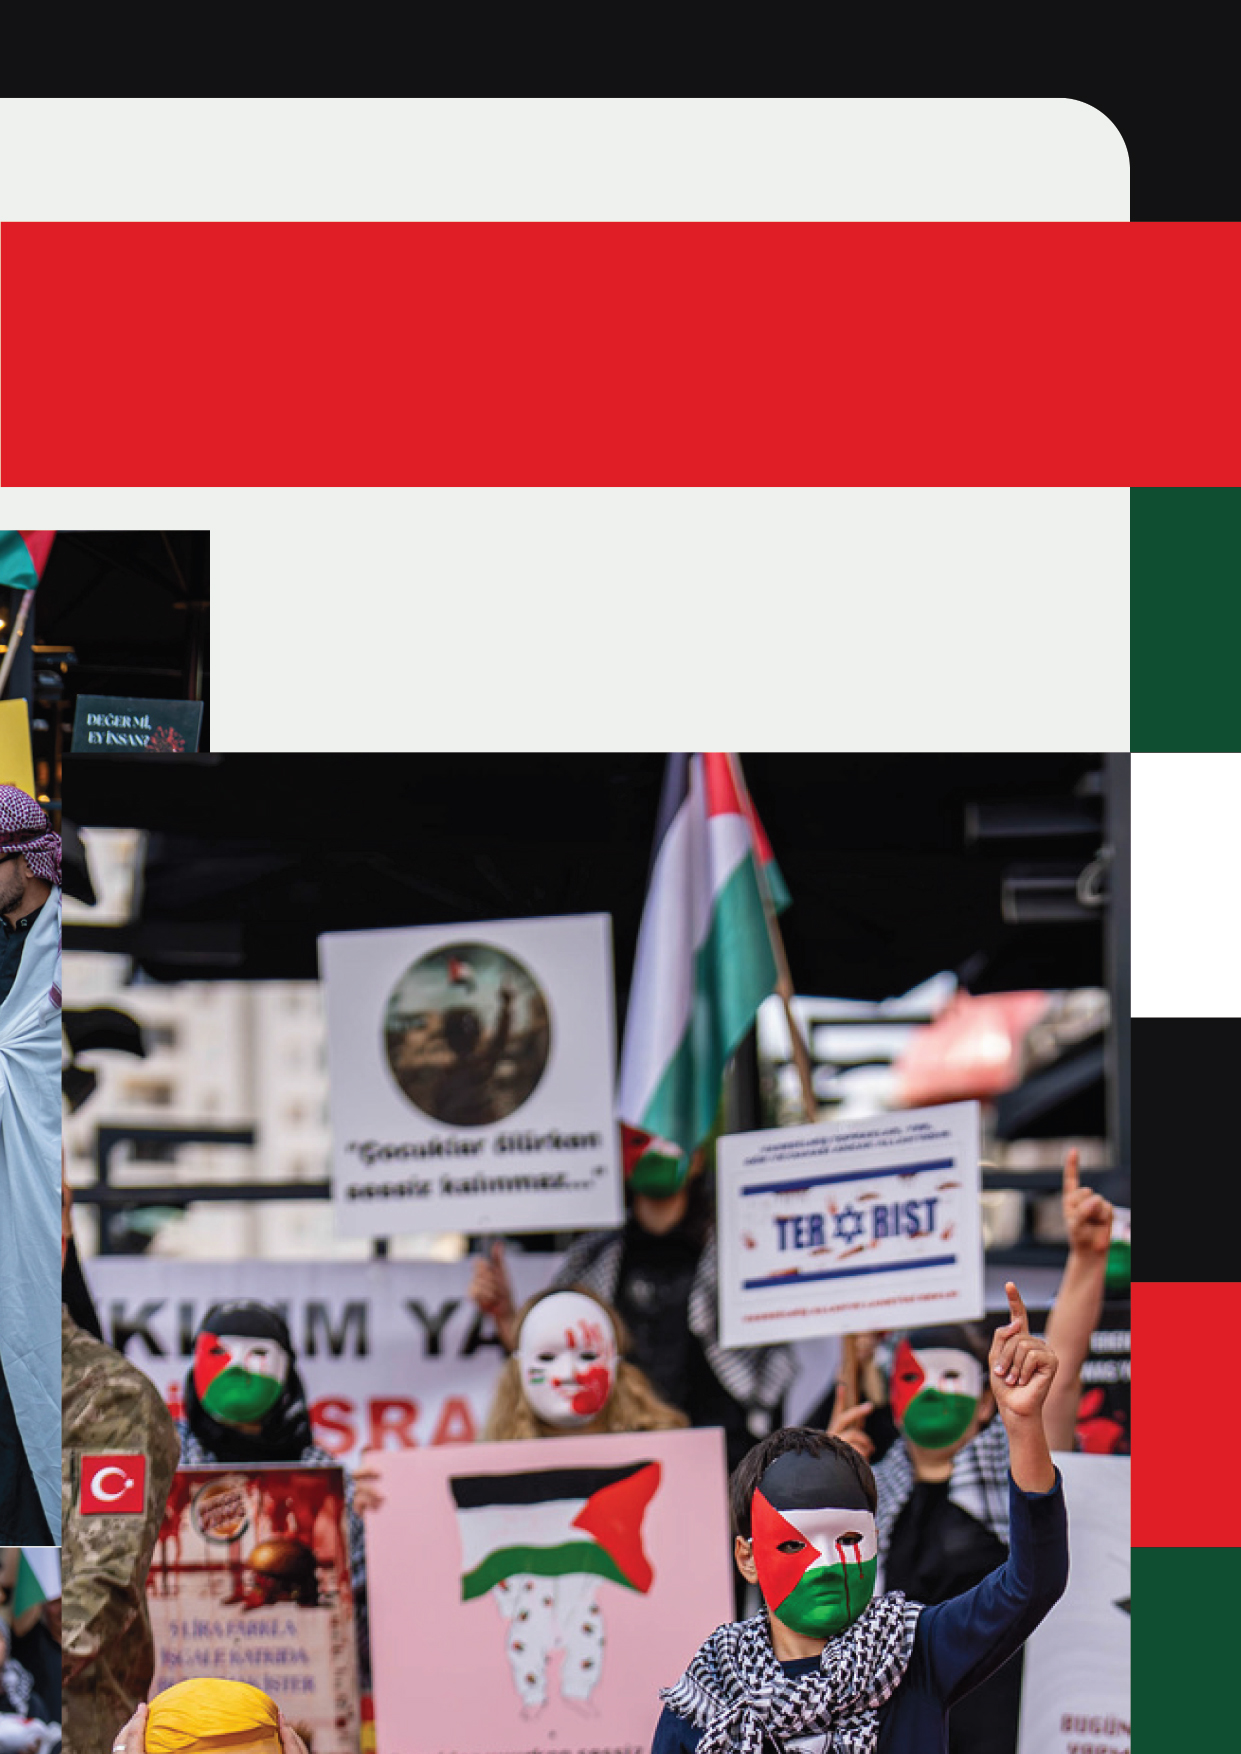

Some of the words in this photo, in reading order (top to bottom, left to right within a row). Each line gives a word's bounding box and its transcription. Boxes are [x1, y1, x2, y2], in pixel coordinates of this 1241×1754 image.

[87, 712, 131, 728] DEĞER
[88, 731, 102, 744] EY
[105, 730, 151, 747] İNSAN?
[775, 1212, 826, 1251] TER
[873, 1197, 939, 1240] RIST
